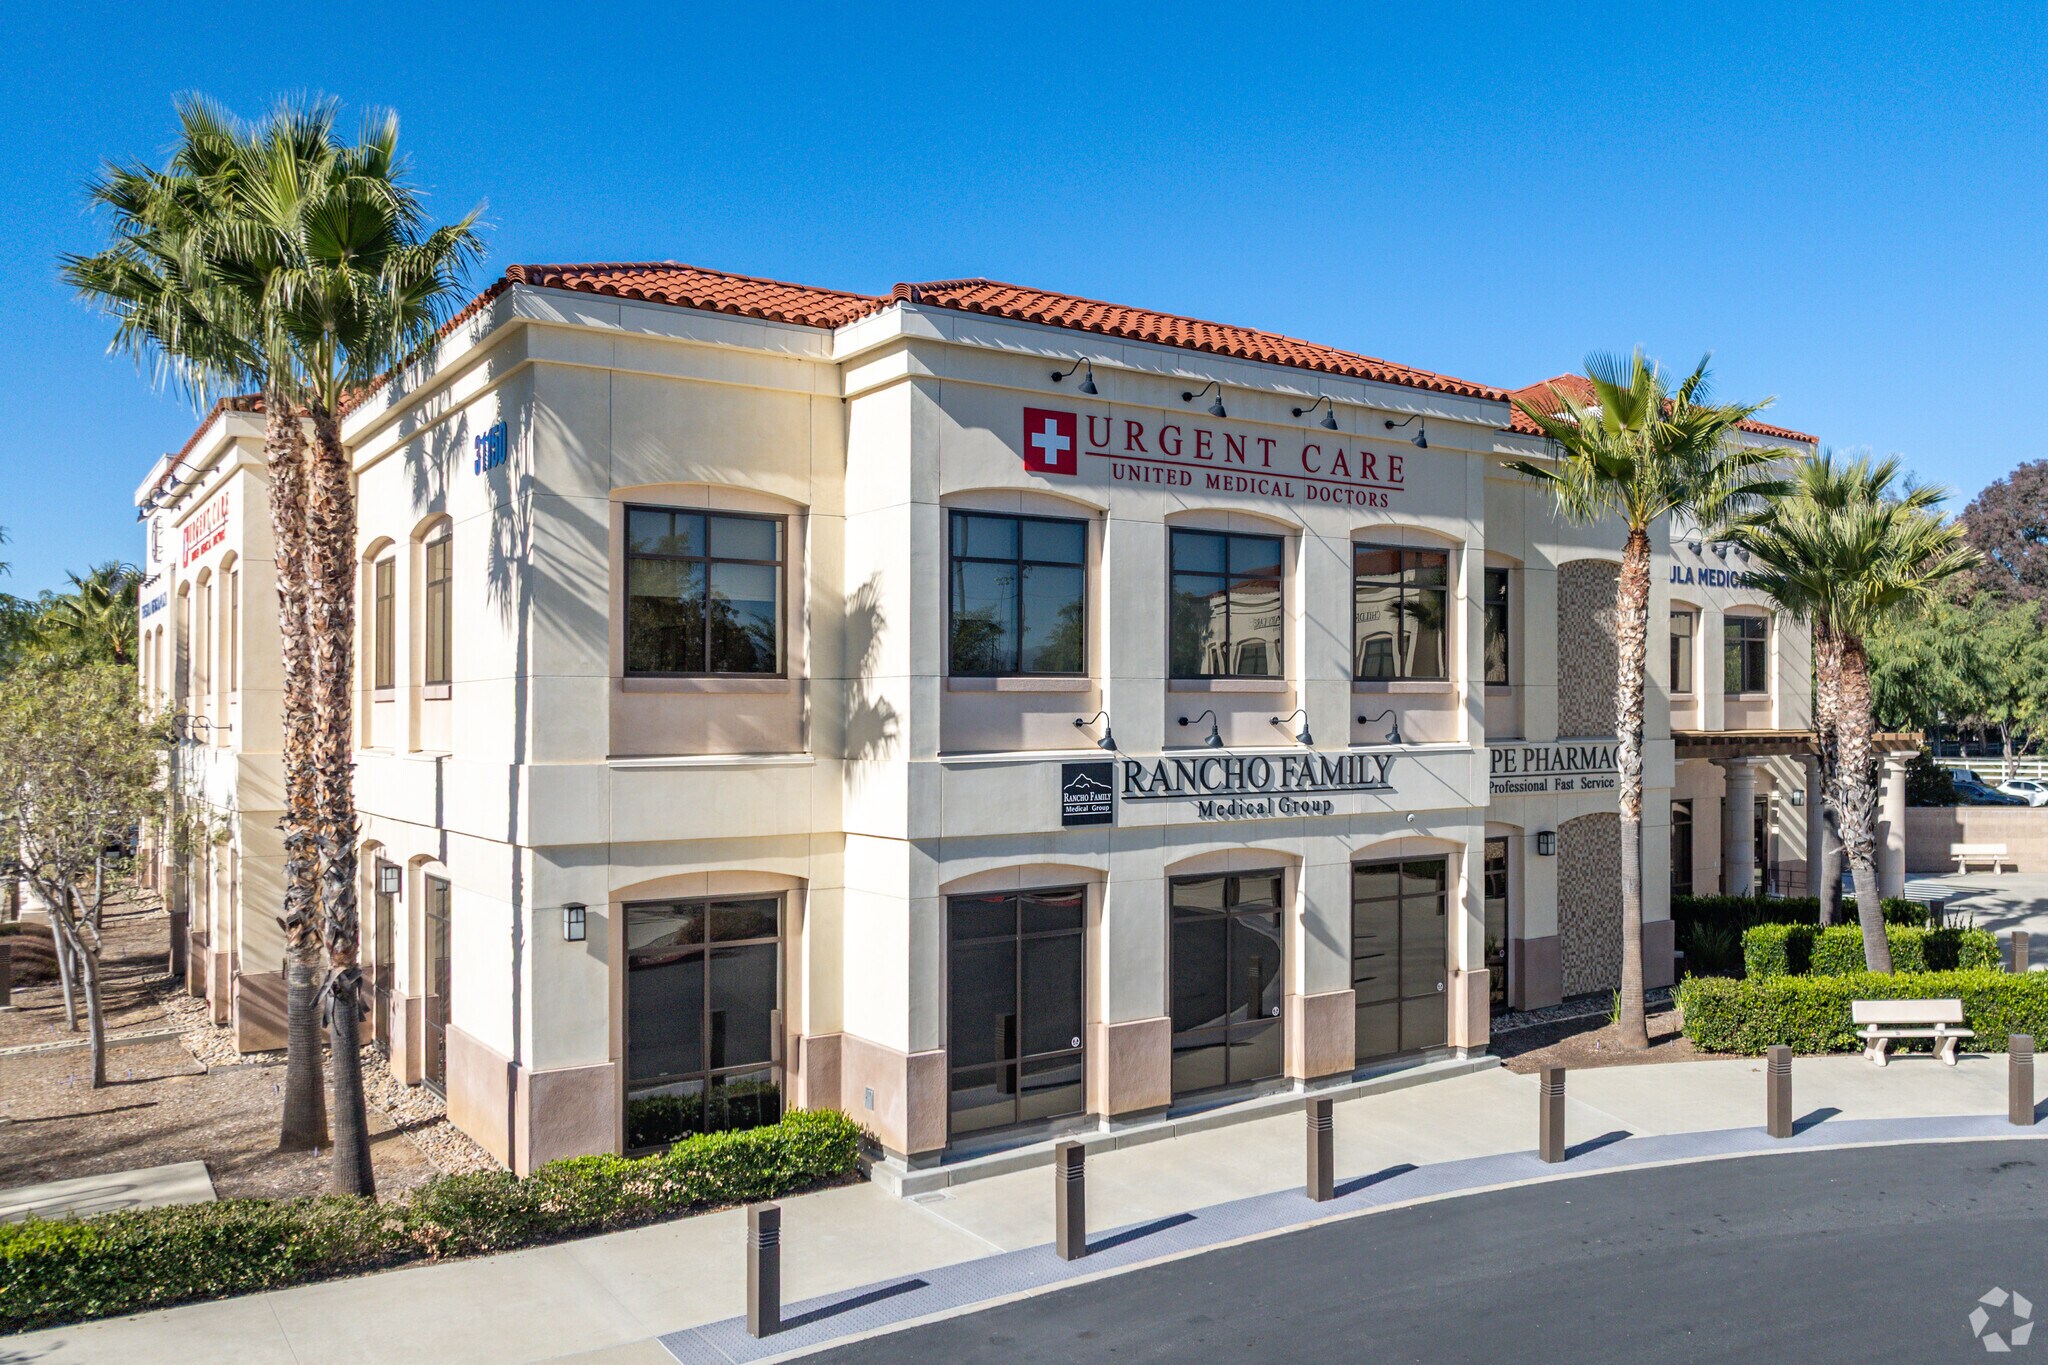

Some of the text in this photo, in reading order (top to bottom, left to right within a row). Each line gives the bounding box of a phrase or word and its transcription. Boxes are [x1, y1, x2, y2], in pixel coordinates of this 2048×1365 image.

[474, 420, 507, 476] 31150
[1087, 414, 1404, 483] URGENT CARE
[1112, 463, 1389, 508] UNITED MEDICAL DOCTORS
[1490, 748, 1517, 773] PE
[1121, 754, 1393, 793] RANCHO FAMILY
[1490, 775, 1615, 794] Professional Fast Service
[1063, 791, 1112, 802] RANCHO FAMILY
[1065, 804, 1110, 813] Medical Group
[1198, 796, 1331, 817] Medical Group
